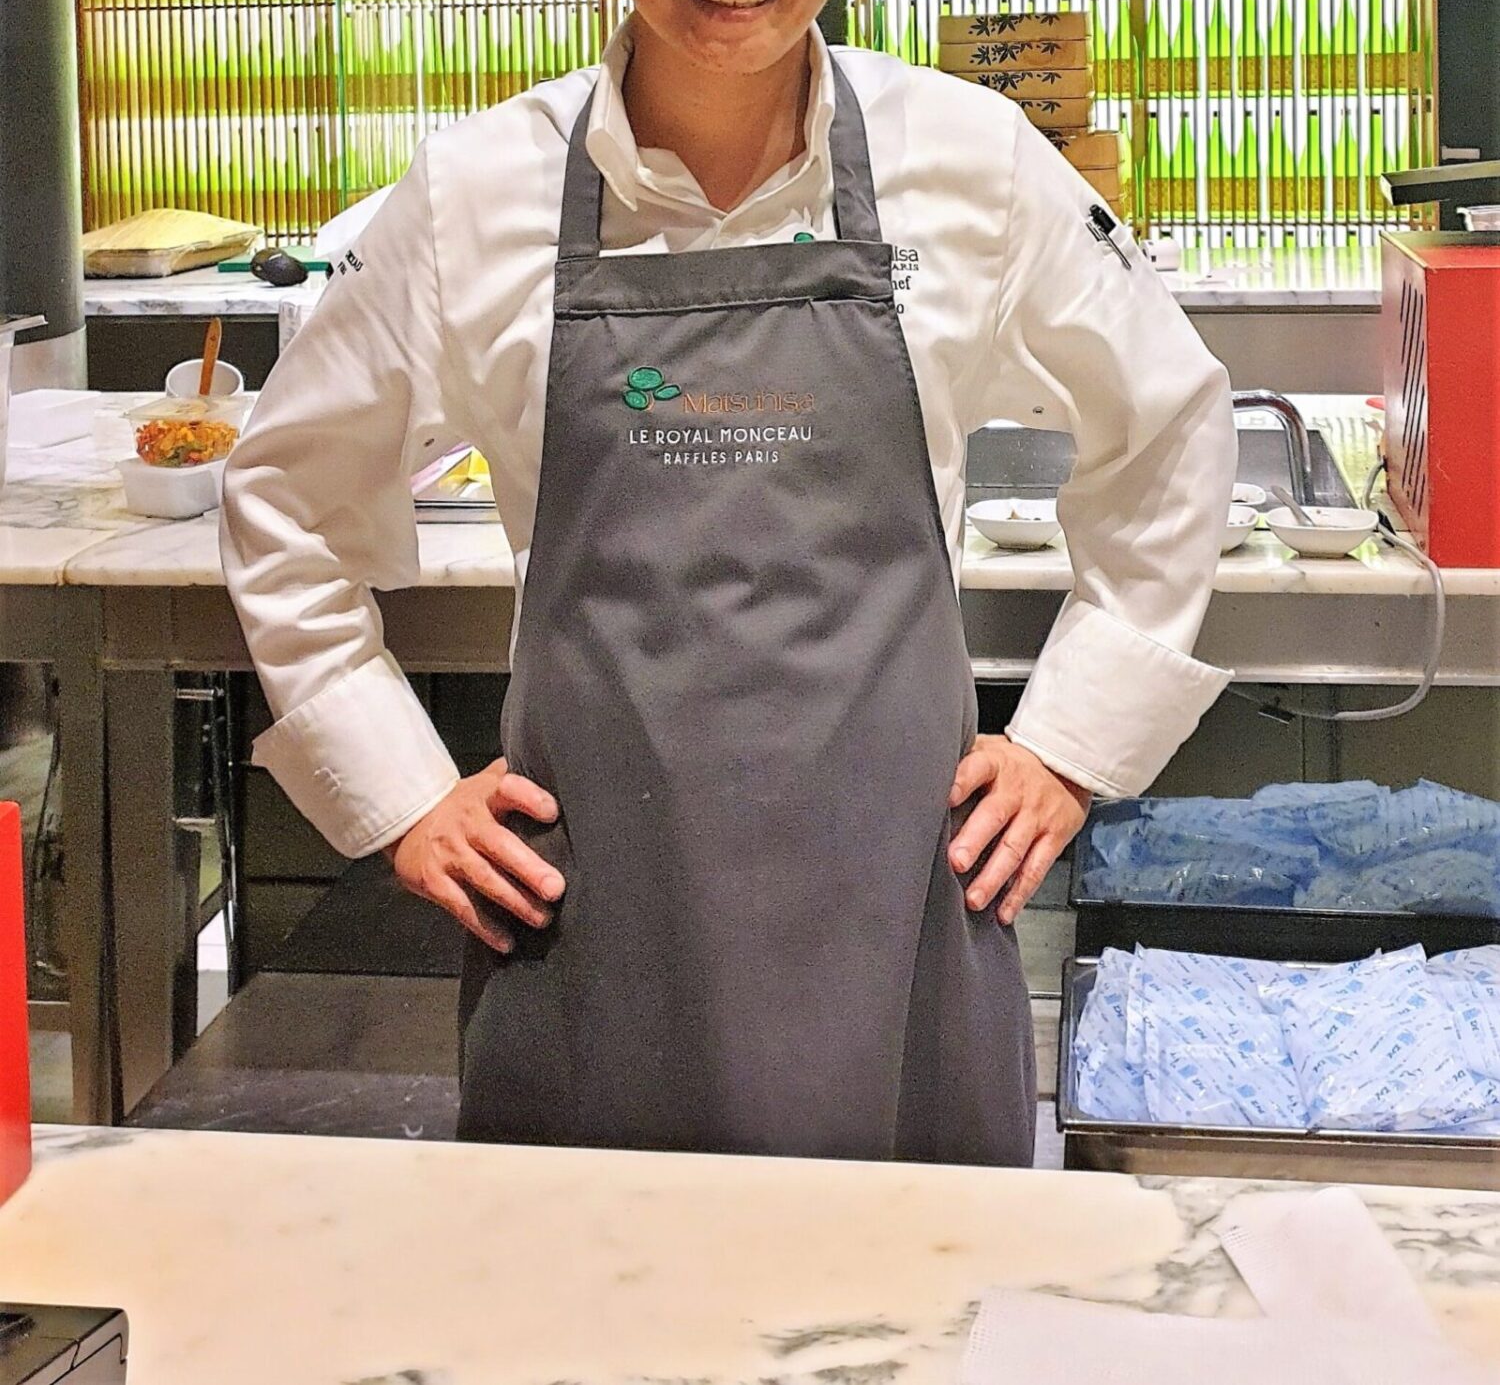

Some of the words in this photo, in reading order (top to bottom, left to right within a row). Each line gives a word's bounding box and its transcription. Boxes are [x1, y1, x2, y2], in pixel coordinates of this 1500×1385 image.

[682, 390, 815, 414] Matsuhisa
[629, 429, 649, 444] LE
[655, 429, 713, 445] ROYAL
[719, 426, 812, 443] MONCEAU
[663, 451, 727, 466] RAFFLES
[734, 450, 779, 464] PARIS
